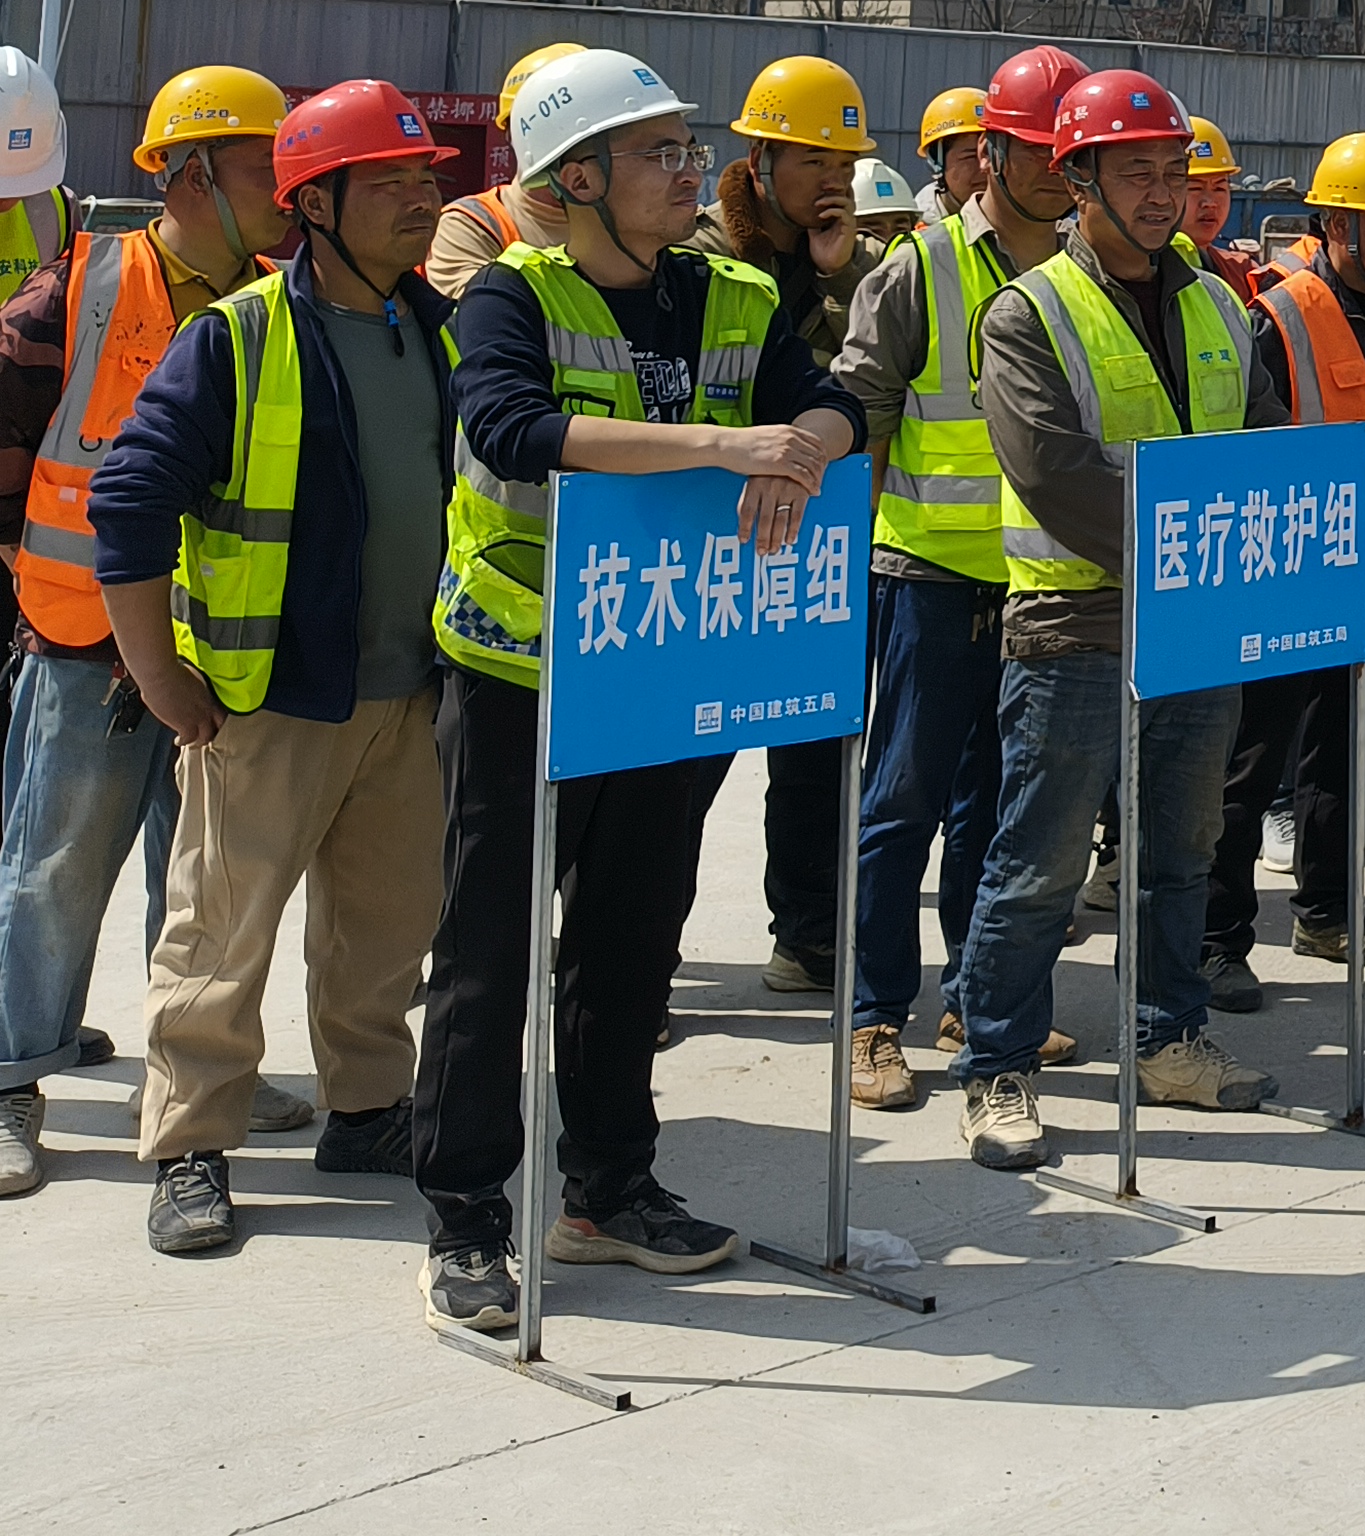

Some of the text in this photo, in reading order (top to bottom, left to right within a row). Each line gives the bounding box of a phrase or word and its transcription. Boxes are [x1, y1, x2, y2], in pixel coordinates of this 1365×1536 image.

[520, 86, 573, 136] A-013
[1154, 481, 1359, 592] 医疗救护组
[578, 524, 851, 655] 技术保障组
[1267, 625, 1347, 653] 中国建筑五局
[730, 692, 836, 724] 中国建筑五局
